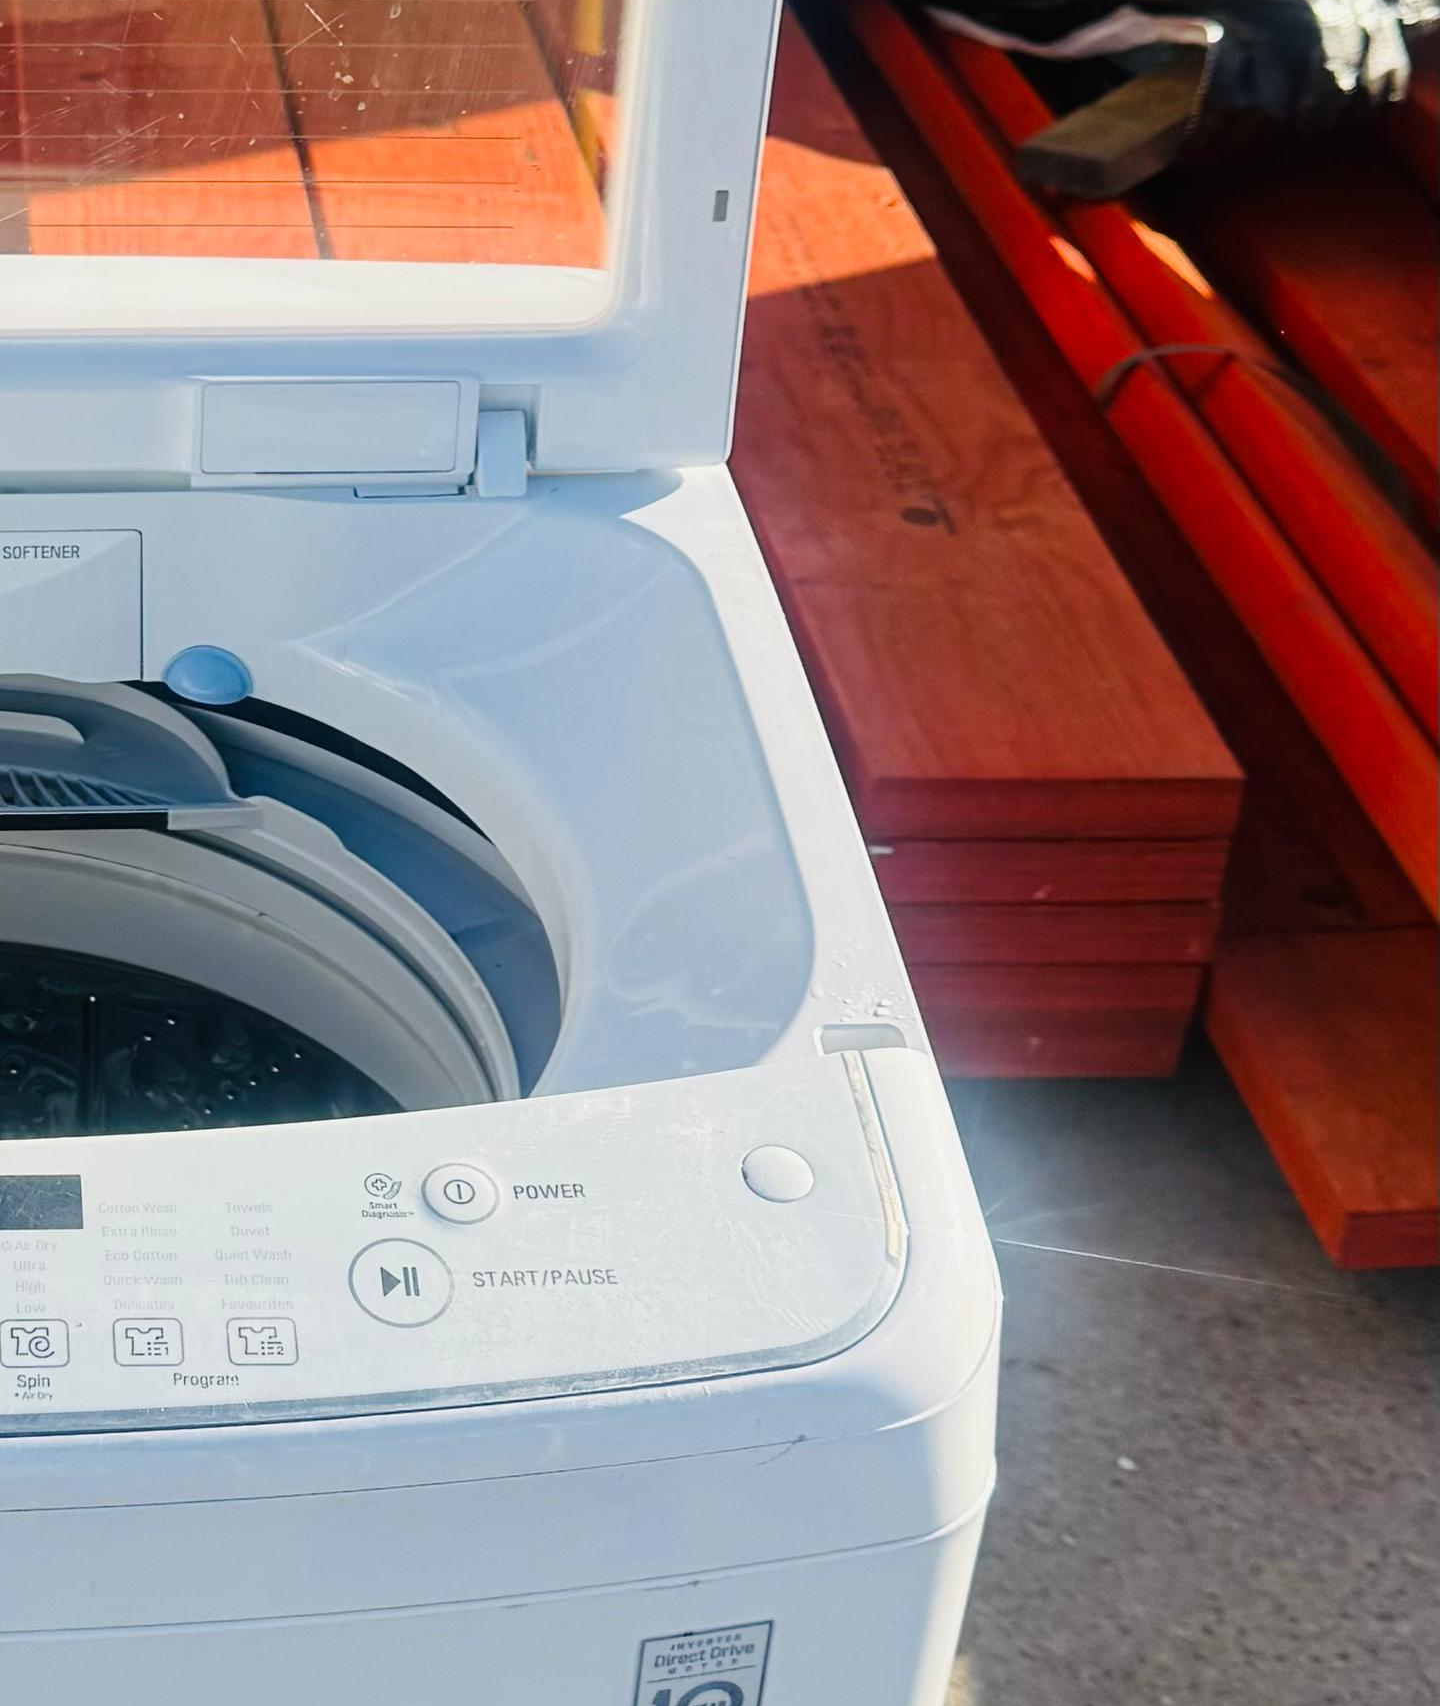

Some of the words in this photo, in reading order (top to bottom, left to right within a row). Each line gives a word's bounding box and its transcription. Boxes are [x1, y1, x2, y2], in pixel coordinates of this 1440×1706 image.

[2, 544, 81, 560] SOFTENER
[513, 1183, 586, 1200] POWER
[98, 1202, 139, 1213] Cotton
[141, 1201, 177, 1213] Wash
[224, 1201, 274, 1213] Towels
[368, 1201, 398, 1210] Smart
[101, 1226, 137, 1237] Extra
[230, 1225, 271, 1237] Duvet
[35, 1240, 58, 1253] Dry
[104, 1250, 129, 1261] Eco
[132, 1250, 177, 1261] Cotton
[214, 1248, 249, 1262] Quiet
[251, 1248, 292, 1261] Wash
[13, 1259, 46, 1271] Ultra
[103, 1274, 139, 1286] Quick
[142, 1273, 183, 1286] Wash
[223, 1273, 247, 1285] Tub
[251, 1273, 289, 1285] Clean
[472, 1268, 619, 1288] START/PAUSE
[15, 1280, 45, 1294] High
[15, 1302, 46, 1315] Low
[114, 1299, 175, 1311] Delicates
[221, 1297, 295, 1310] Favourites
[16, 1374, 51, 1390] Spin
[172, 1372, 241, 1389] Program
[669, 1633, 742, 1651] INVERTER
[654, 1650, 707, 1668] Direct
[709, 1643, 755, 1659] Drive
[667, 1658, 739, 1675] MOTOR
